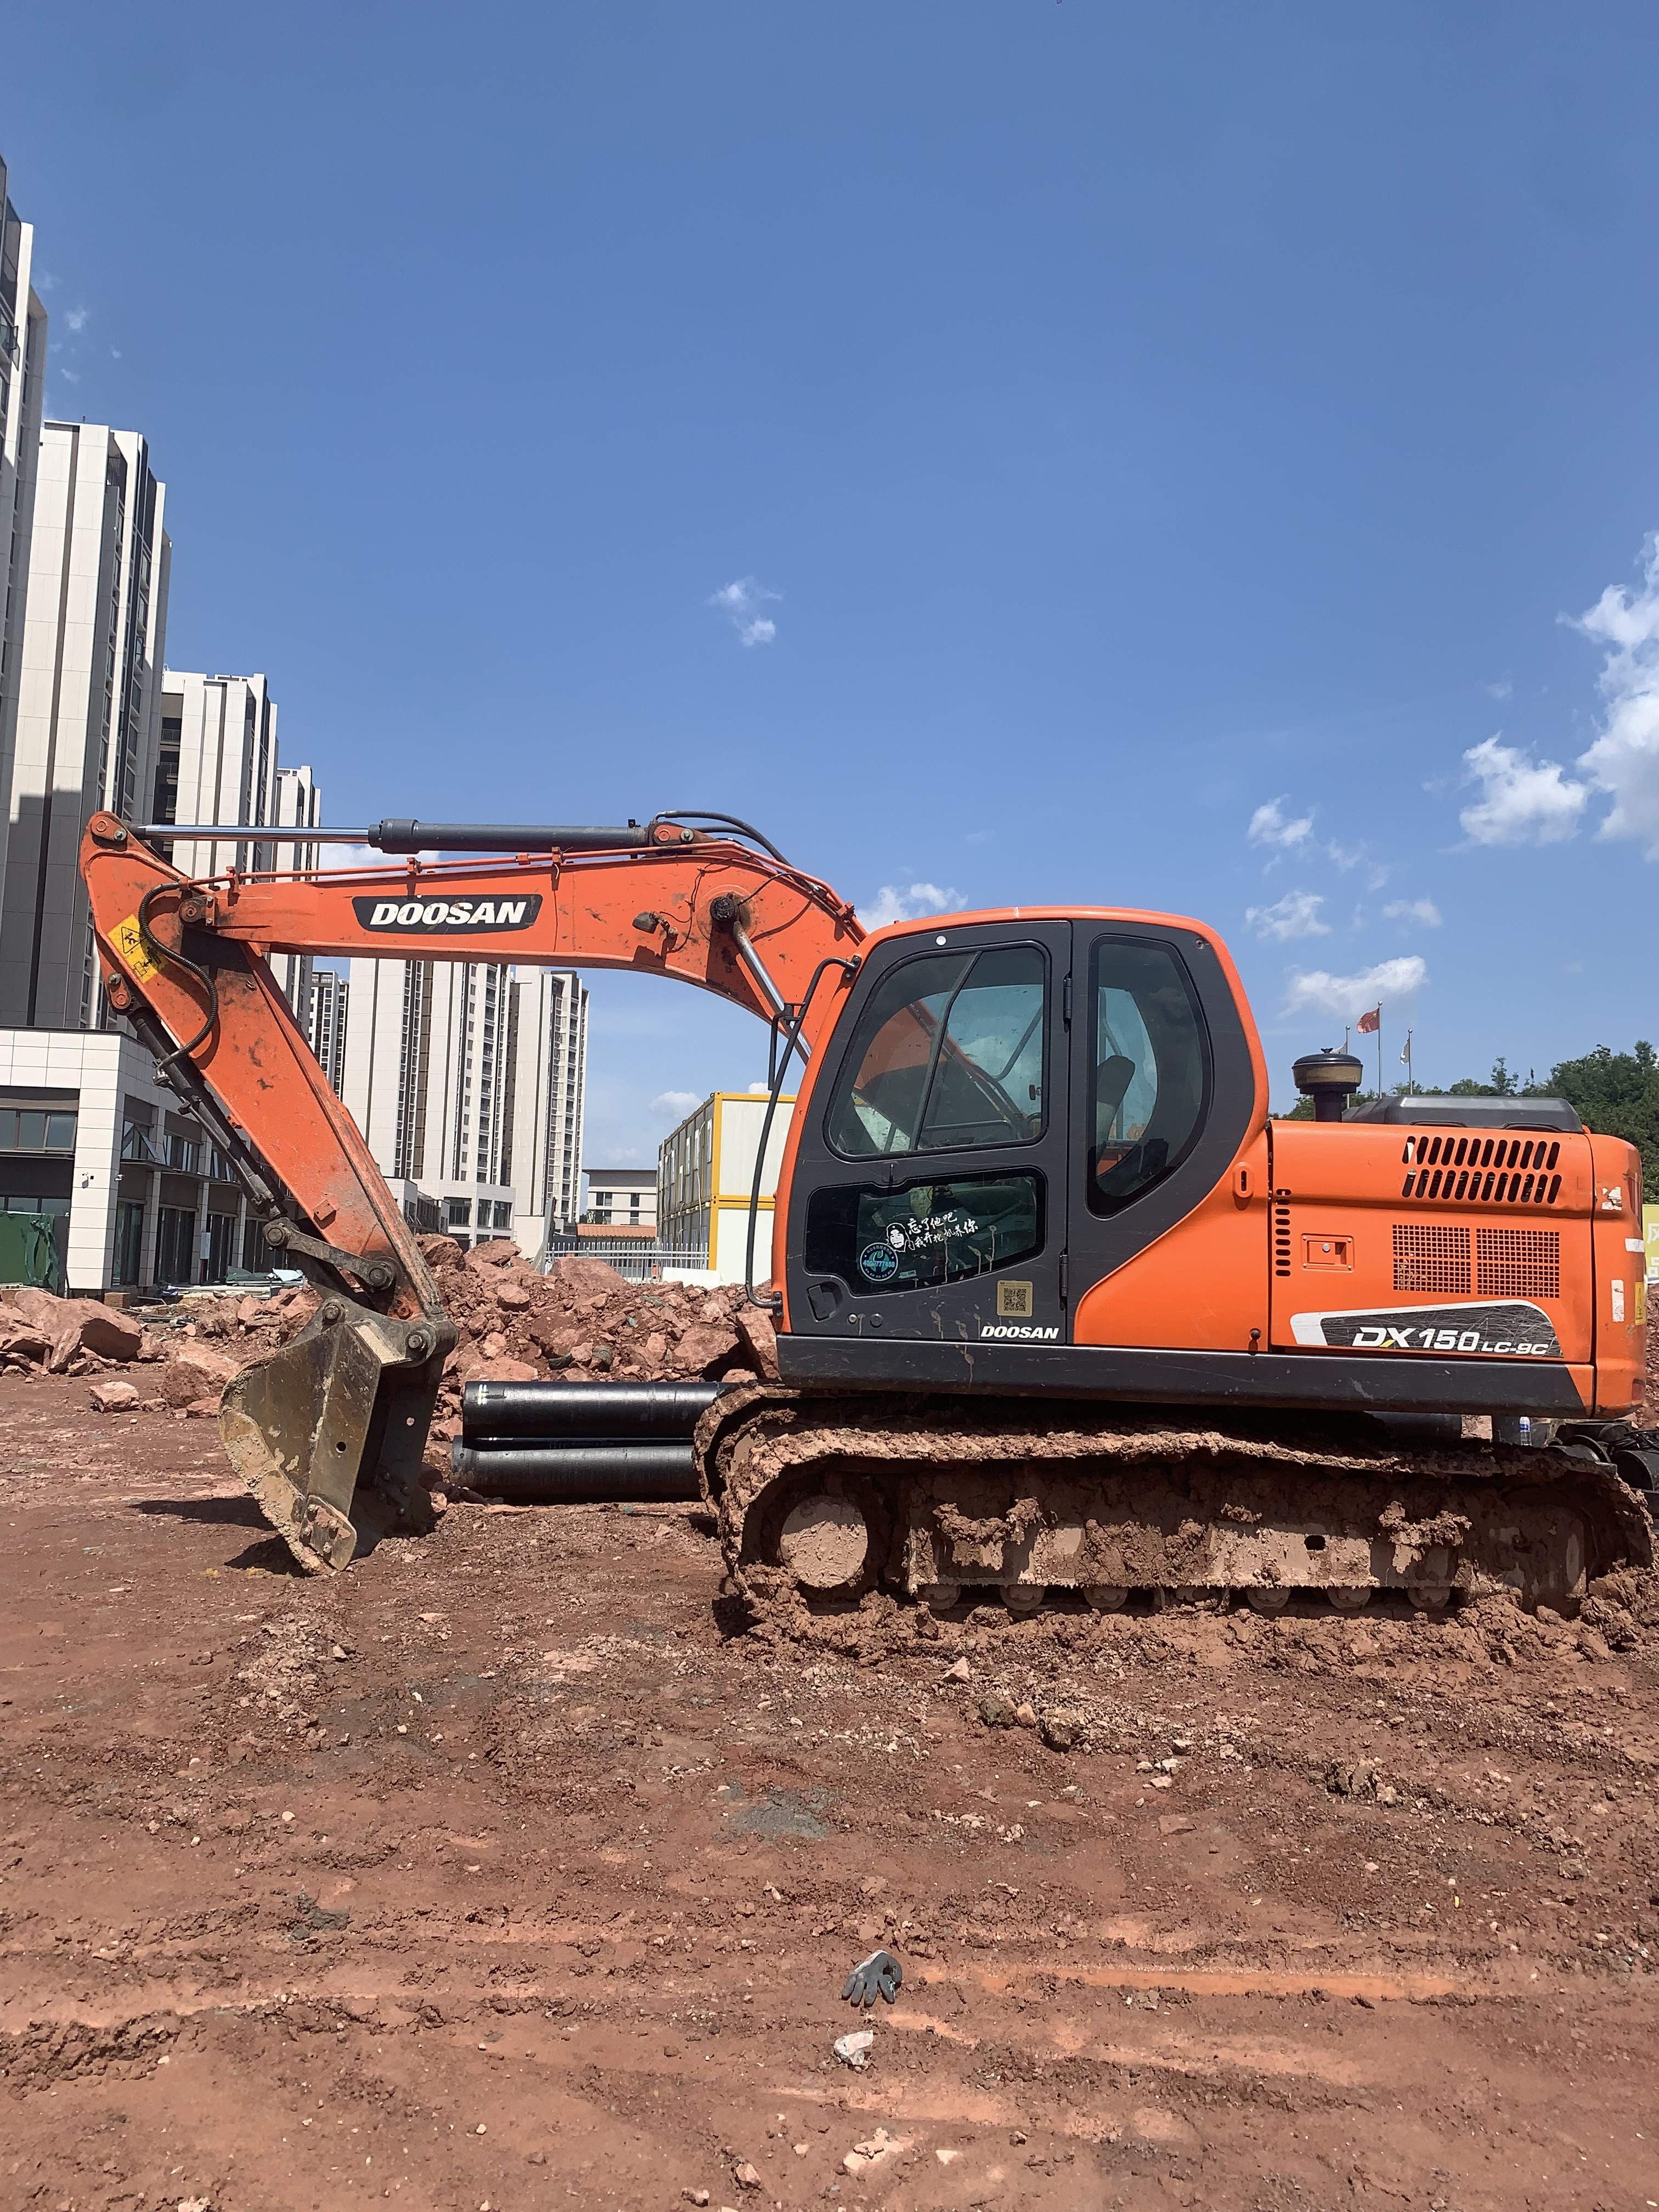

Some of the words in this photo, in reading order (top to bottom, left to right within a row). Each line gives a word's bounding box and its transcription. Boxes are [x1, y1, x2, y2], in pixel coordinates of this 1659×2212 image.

[370, 902, 527, 925] DOOSAN
[907, 1211, 957, 1235] 忘了他吧
[980, 1325, 1059, 1339] DOOSAN
